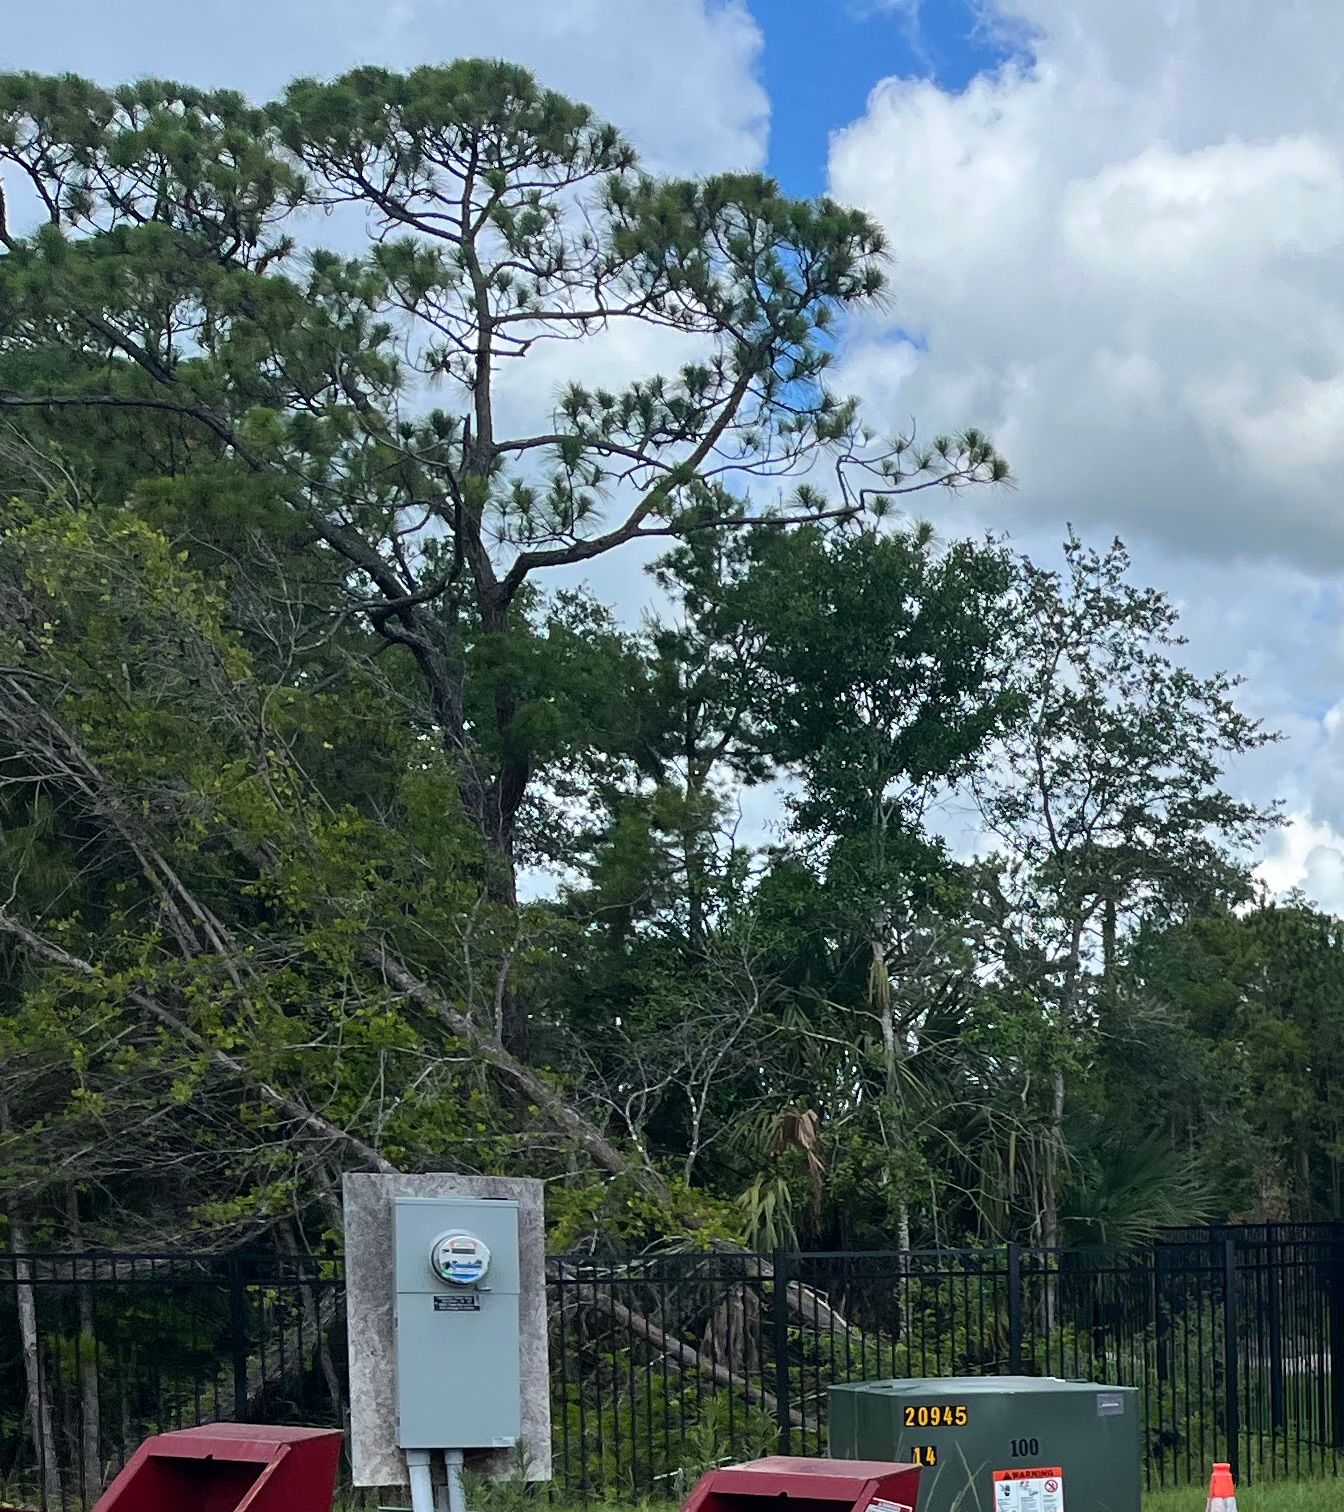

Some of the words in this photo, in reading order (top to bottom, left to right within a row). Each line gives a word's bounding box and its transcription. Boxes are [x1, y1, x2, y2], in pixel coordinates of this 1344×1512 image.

[905, 1405, 968, 1427] 20945
[912, 1446, 937, 1466] 14
[1010, 1438, 1039, 1458] 100
[1012, 1469, 1055, 1480] WARNING
